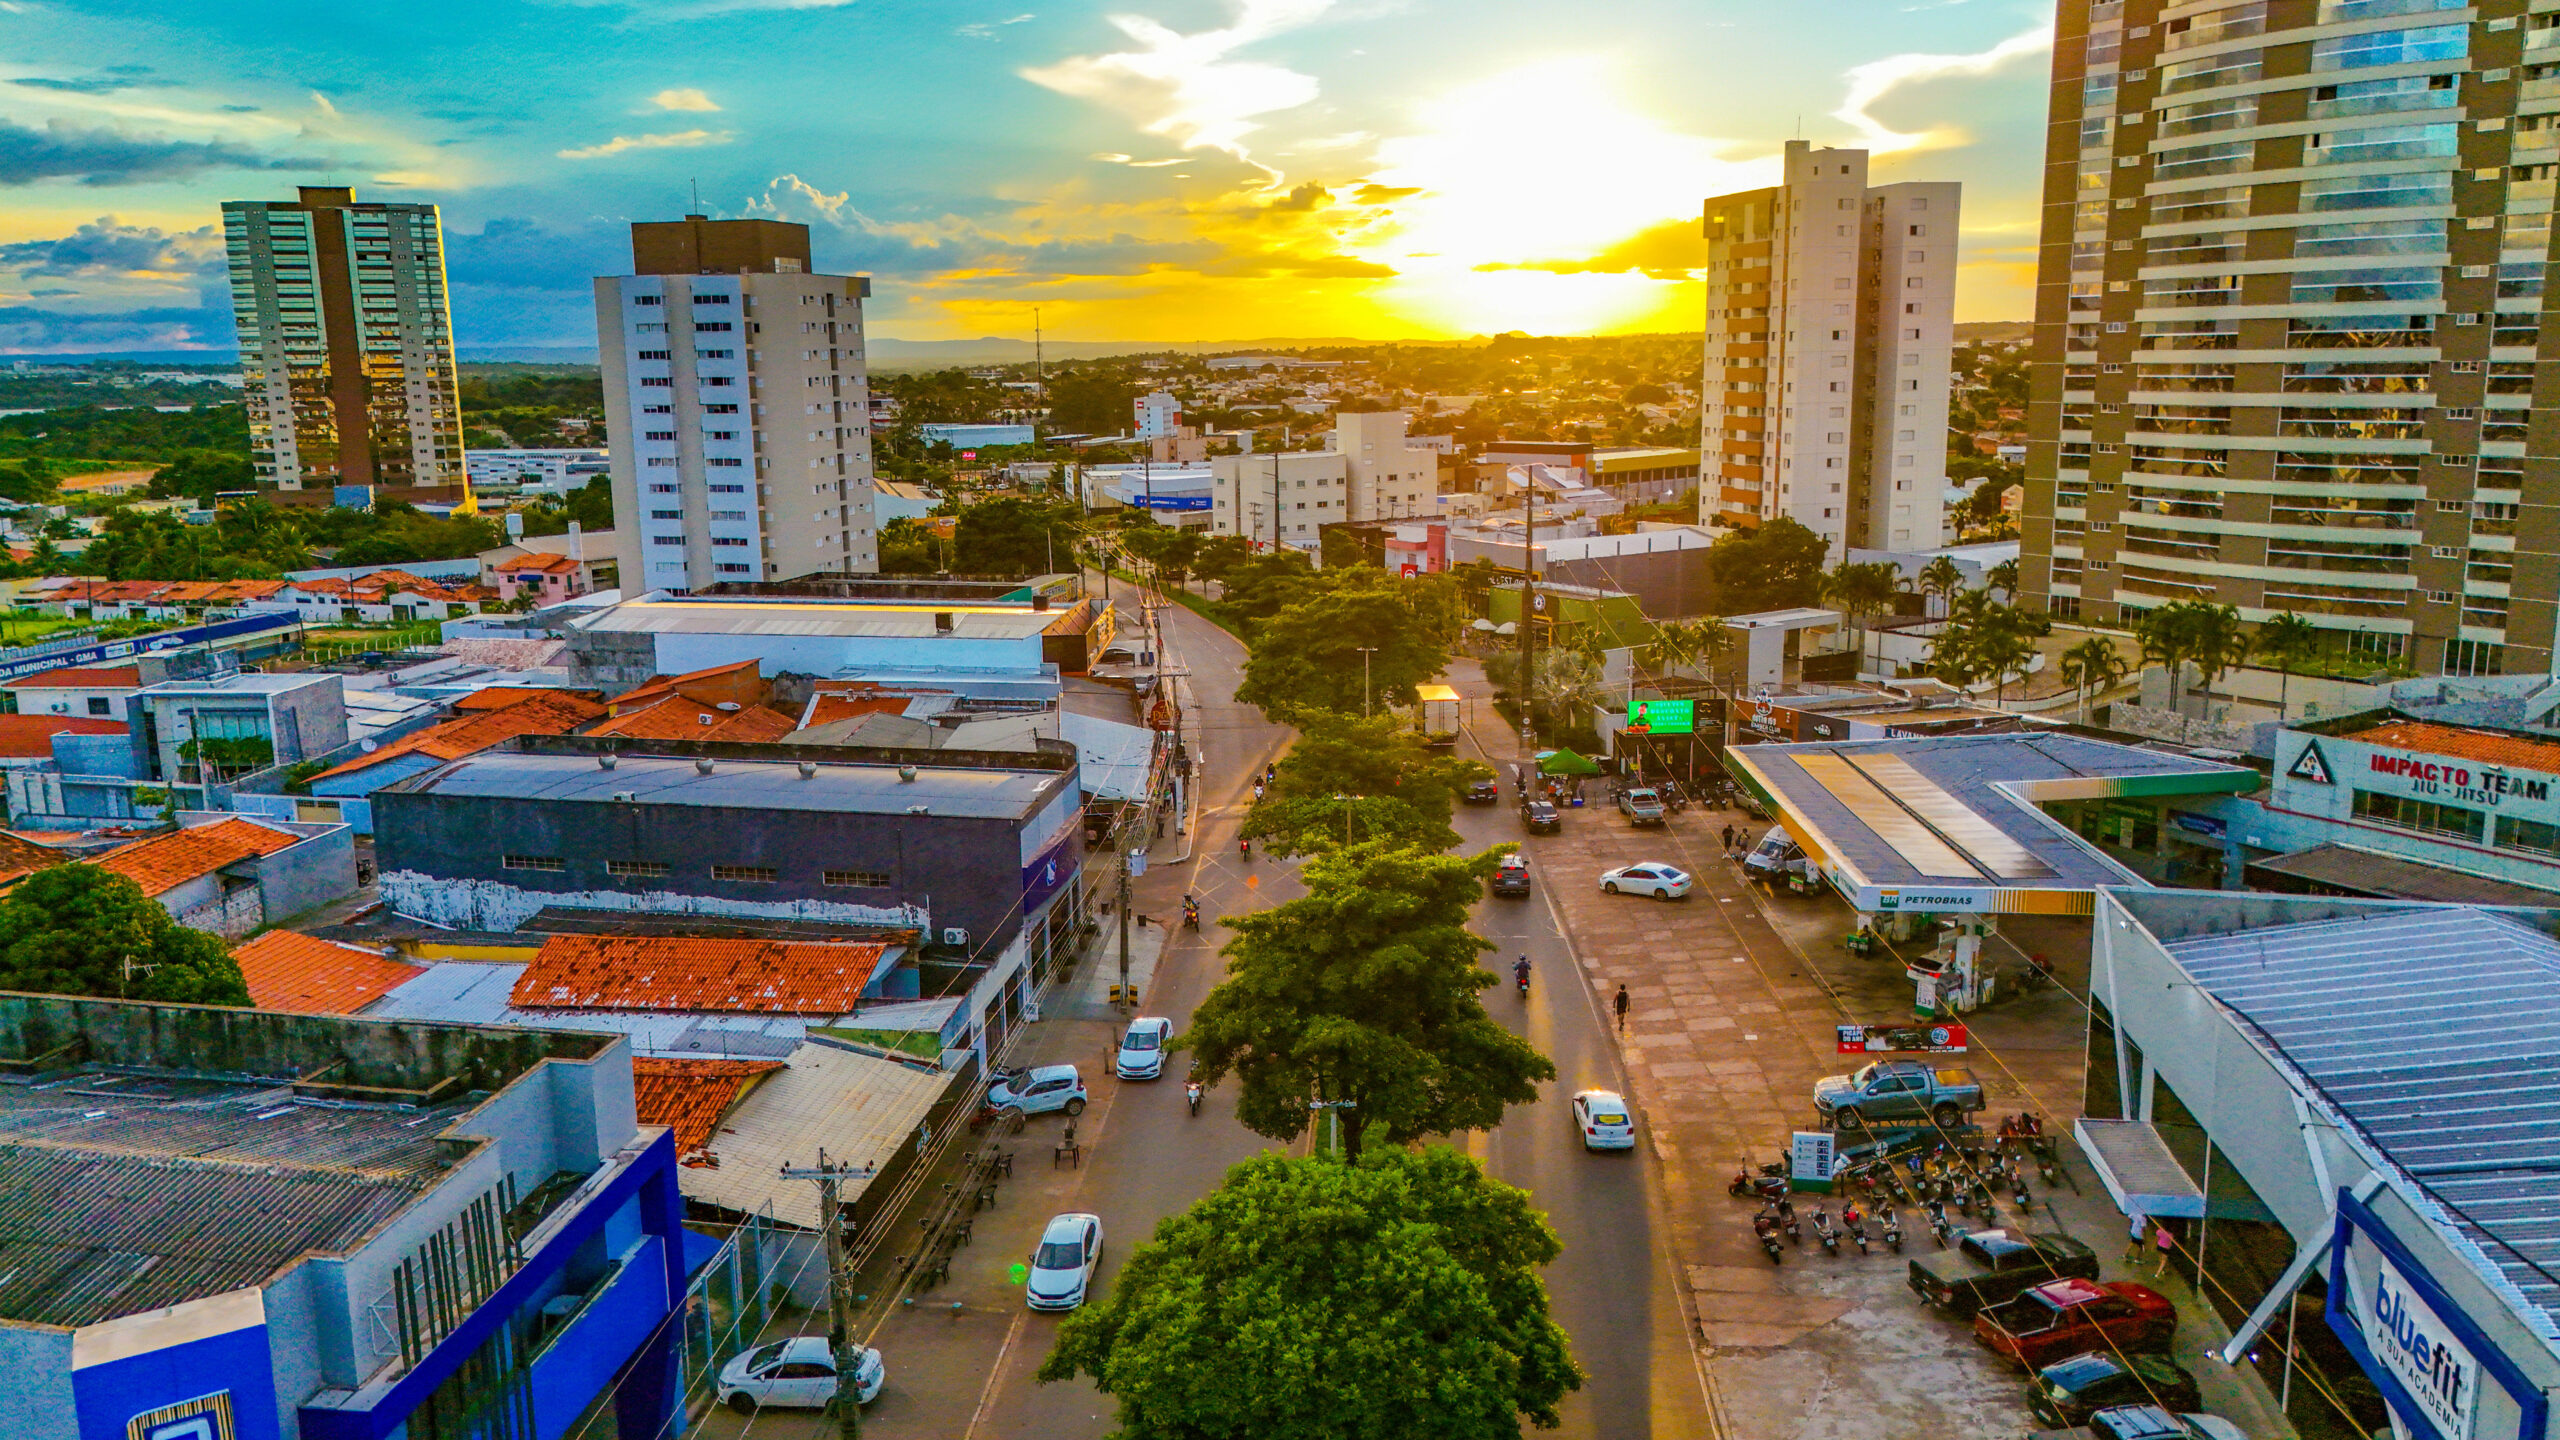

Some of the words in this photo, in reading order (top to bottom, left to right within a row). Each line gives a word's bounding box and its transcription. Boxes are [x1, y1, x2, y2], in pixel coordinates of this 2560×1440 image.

[14, 656, 68, 675] MUNICIPAL
[76, 651, 97, 663] GMA
[2370, 754, 2469, 787] IMPACTO
[2480, 772, 2548, 800] TEAM
[2411, 779, 2437, 794] JIU
[2454, 787, 2499, 805] JITSU
[1904, 896, 1972, 905] PETROBRAS
[2376, 1271, 2463, 1415] bluefit
[2377, 1328, 2384, 1343] A
[2386, 1338, 2405, 1370] SUA
[2408, 1367, 2461, 1440] ACADEMIA
